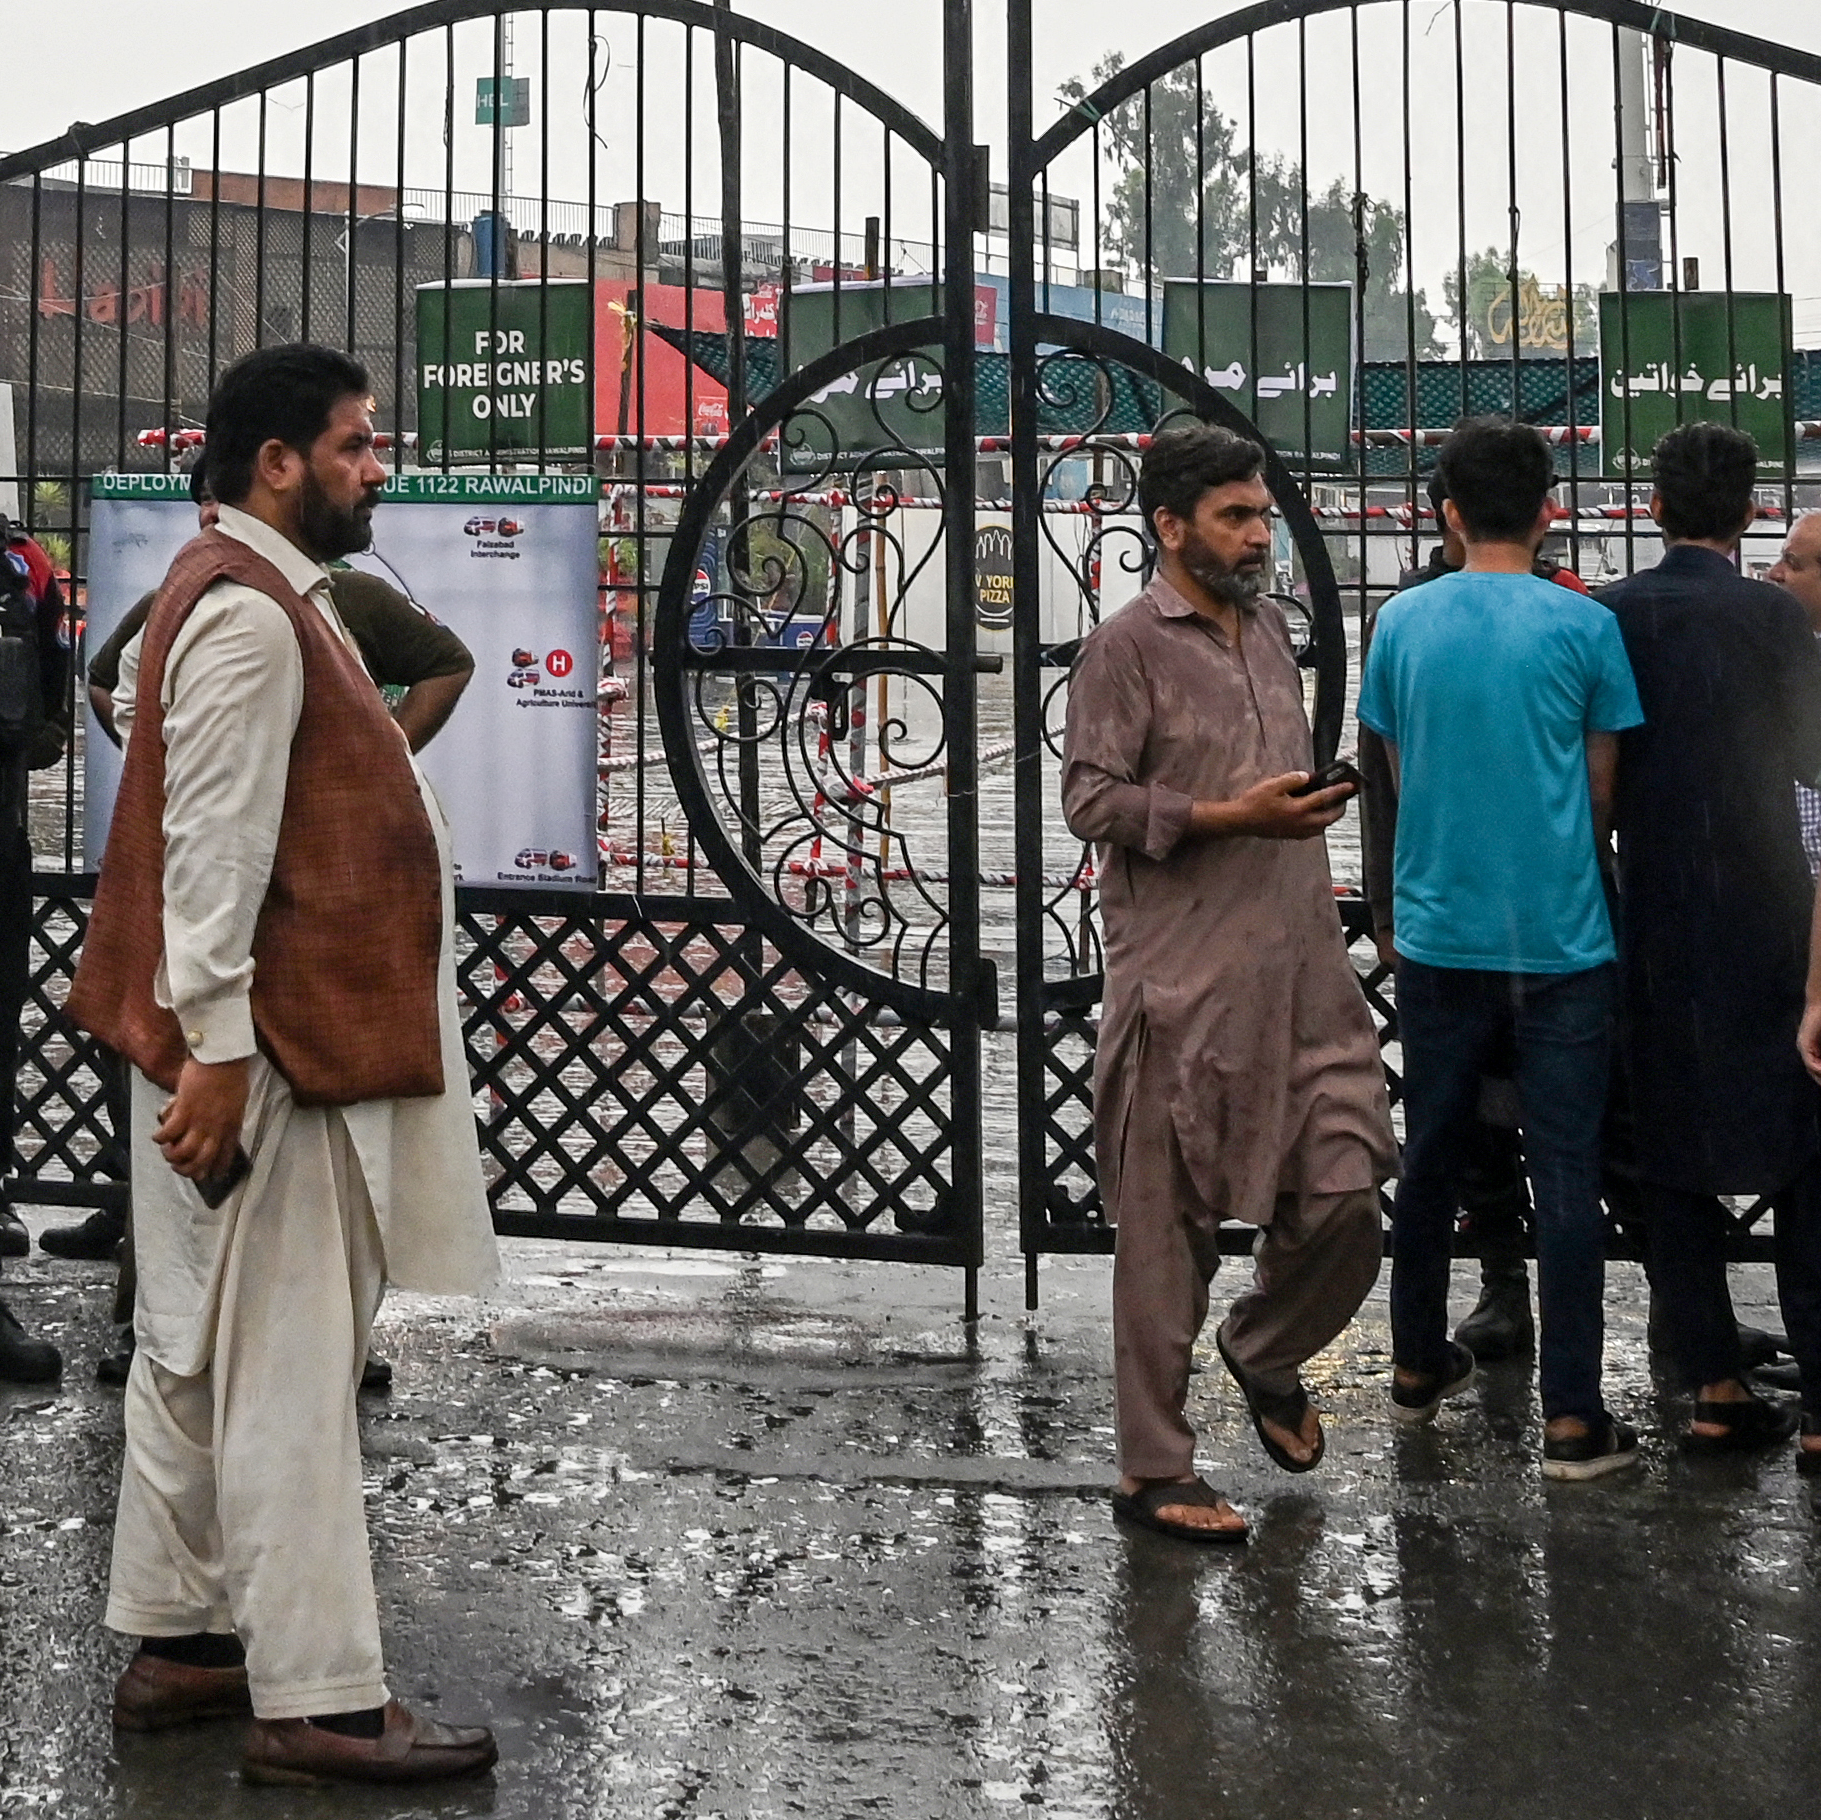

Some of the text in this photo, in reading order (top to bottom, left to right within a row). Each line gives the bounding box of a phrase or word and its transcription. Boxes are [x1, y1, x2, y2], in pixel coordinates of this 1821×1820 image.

[475, 330, 525, 355] FOR
[1257, 361, 1337, 399] برائے
[1610, 361, 1782, 401] برائے خواتین
[472, 393, 537, 419] ONLY
[816, 451, 848, 461] DISTICT
[416, 477, 459, 494] 1122
[465, 477, 593, 495] RAWALPINDI
[476, 540, 515, 549] Faizabad
[470, 550, 521, 560] Interchange
[980, 588, 1011, 604] PIZZA
[537, 873, 573, 884] Stadium
